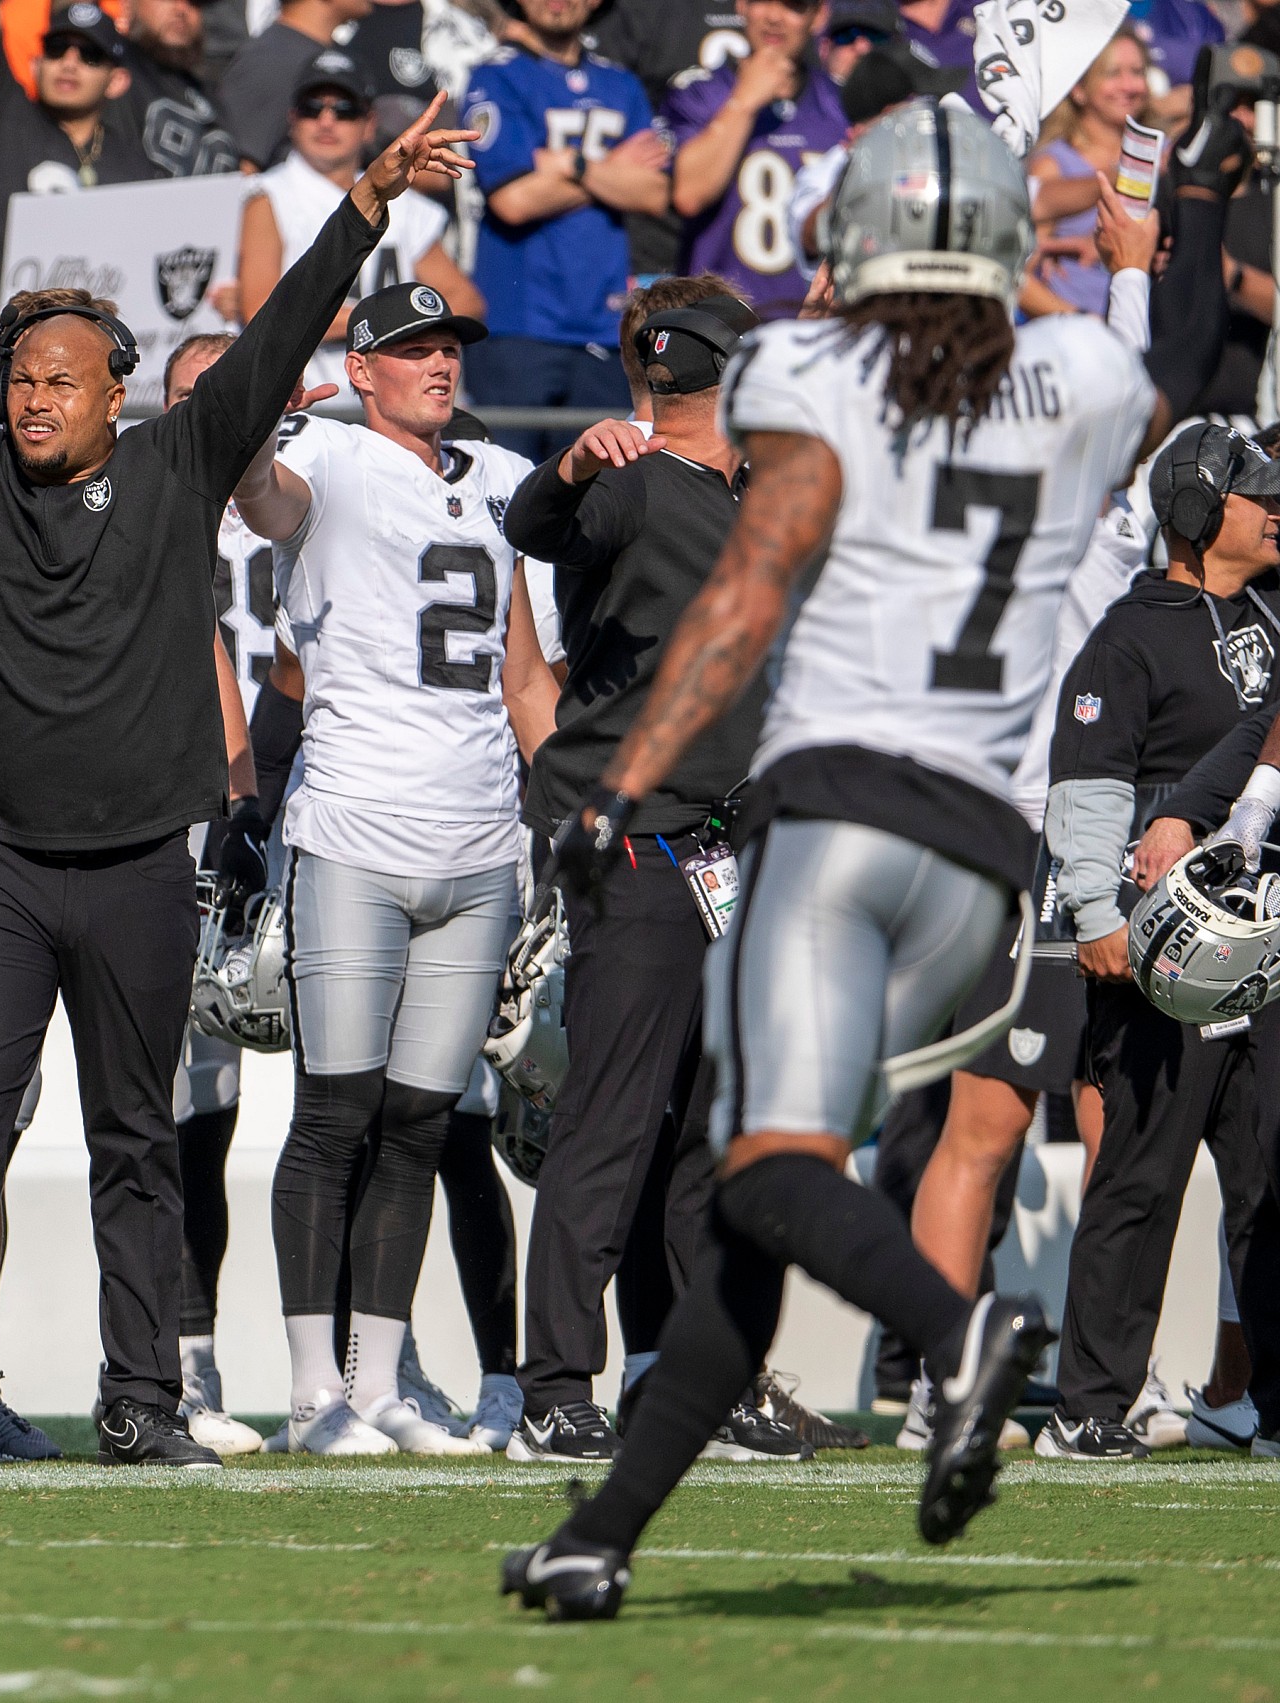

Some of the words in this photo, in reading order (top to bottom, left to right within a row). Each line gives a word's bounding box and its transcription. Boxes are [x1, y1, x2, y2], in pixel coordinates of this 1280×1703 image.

[417, 541, 497, 694] 2
[926, 461, 1045, 692] 7
[1173, 887, 1212, 924] RAIDERS
